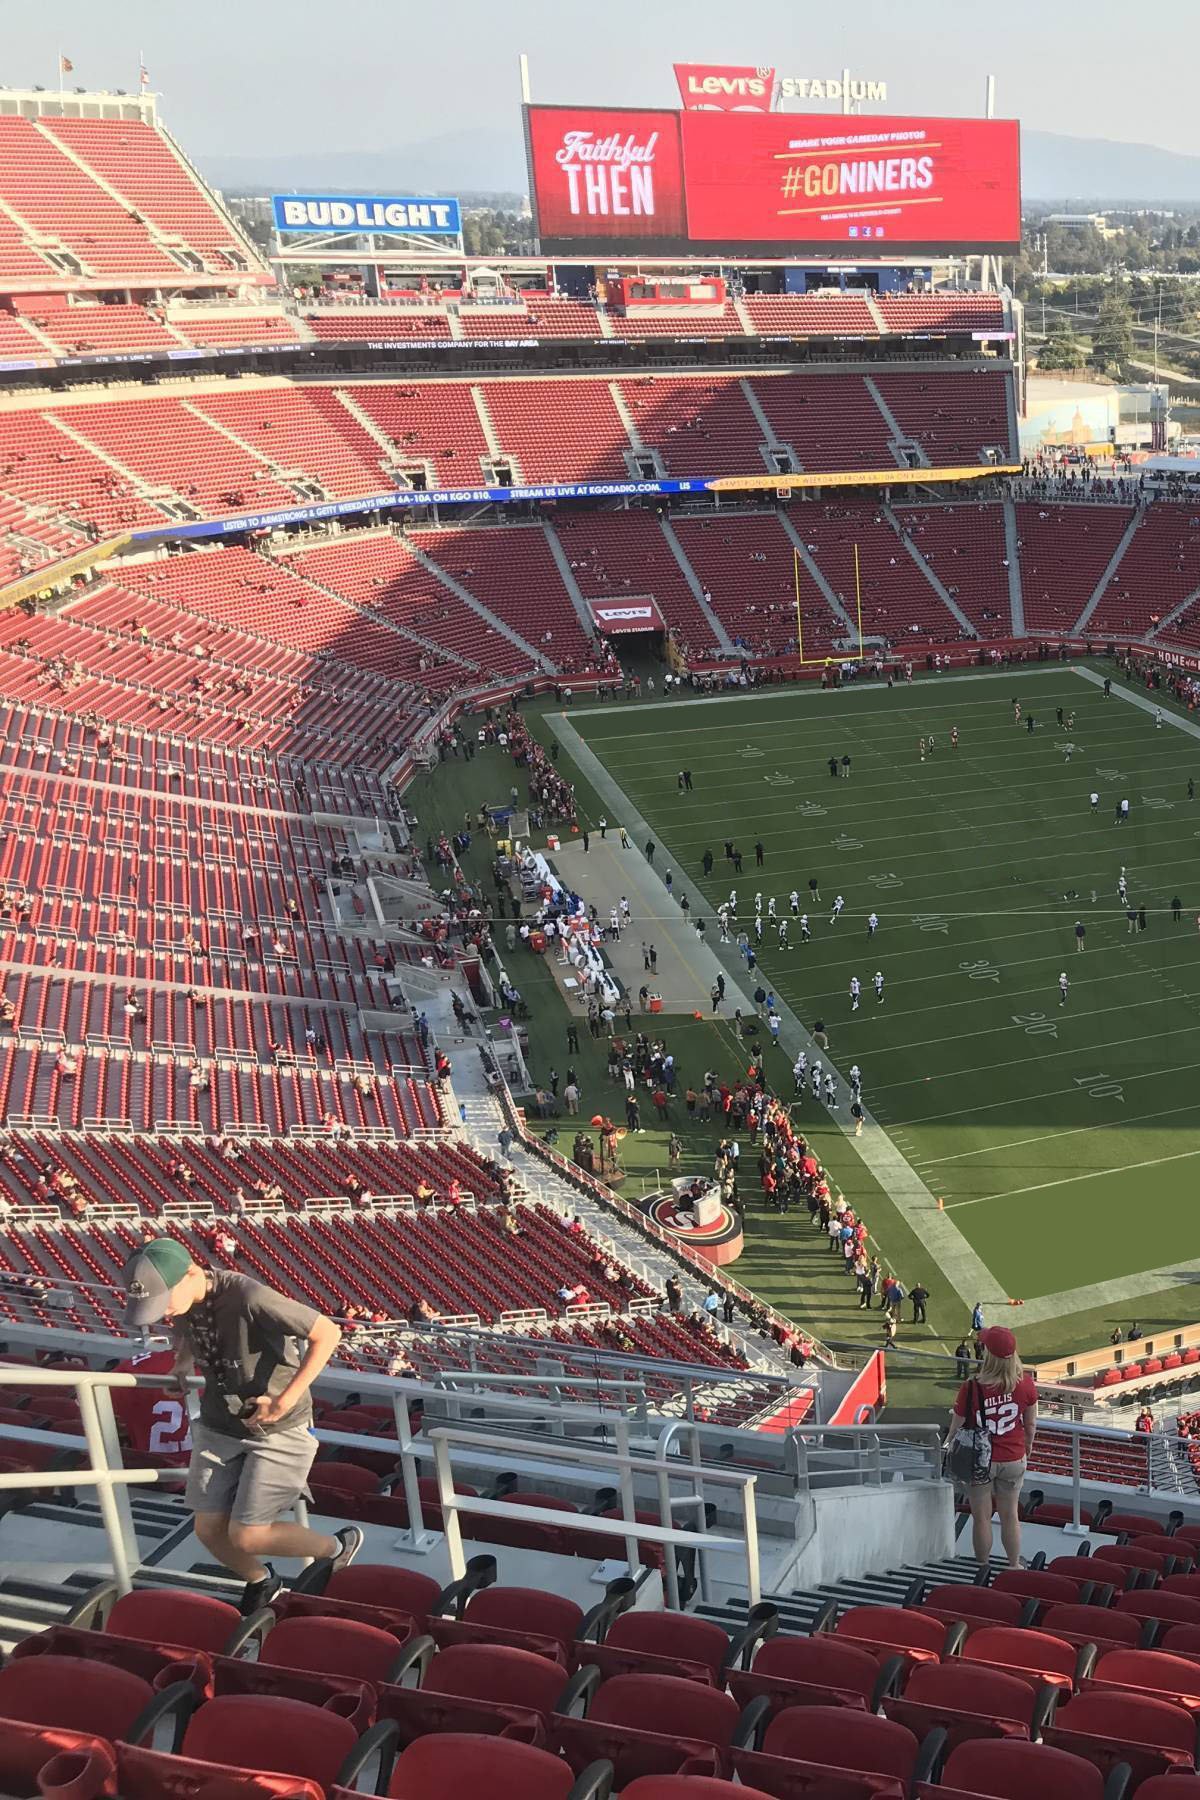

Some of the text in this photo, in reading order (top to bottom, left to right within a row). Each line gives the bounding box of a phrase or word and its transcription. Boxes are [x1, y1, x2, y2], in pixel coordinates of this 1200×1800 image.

[781, 78, 887, 101] STADIUM
[556, 131, 656, 169] Faithful
[820, 136, 846, 146] YOUR
[562, 163, 655, 215] THEN
[781, 156, 933, 198] #GONINERS
[284, 201, 450, 228] BUD LIGHT
[510, 483, 662, 498] STREAM US LIVE AT KGORADIO.COM.
[248, 518, 259, 529] TO
[261, 510, 308, 525] ARMSTRONG
[309, 509, 315, 518] &
[316, 505, 338, 517] GETTY
[339, 500, 376, 513] WEEKDAYS
[398, 494, 431, 504] 6A-10A
[433, 493, 448, 501] ON
[450, 492, 471, 500] KGO
[1158, 650, 1185, 667] HOME
[958, 960, 1000, 979] 30
[1010, 1011, 1057, 1034] 20
[1073, 1072, 1123, 1098] 10
[976, 1402, 1019, 1436] 52
